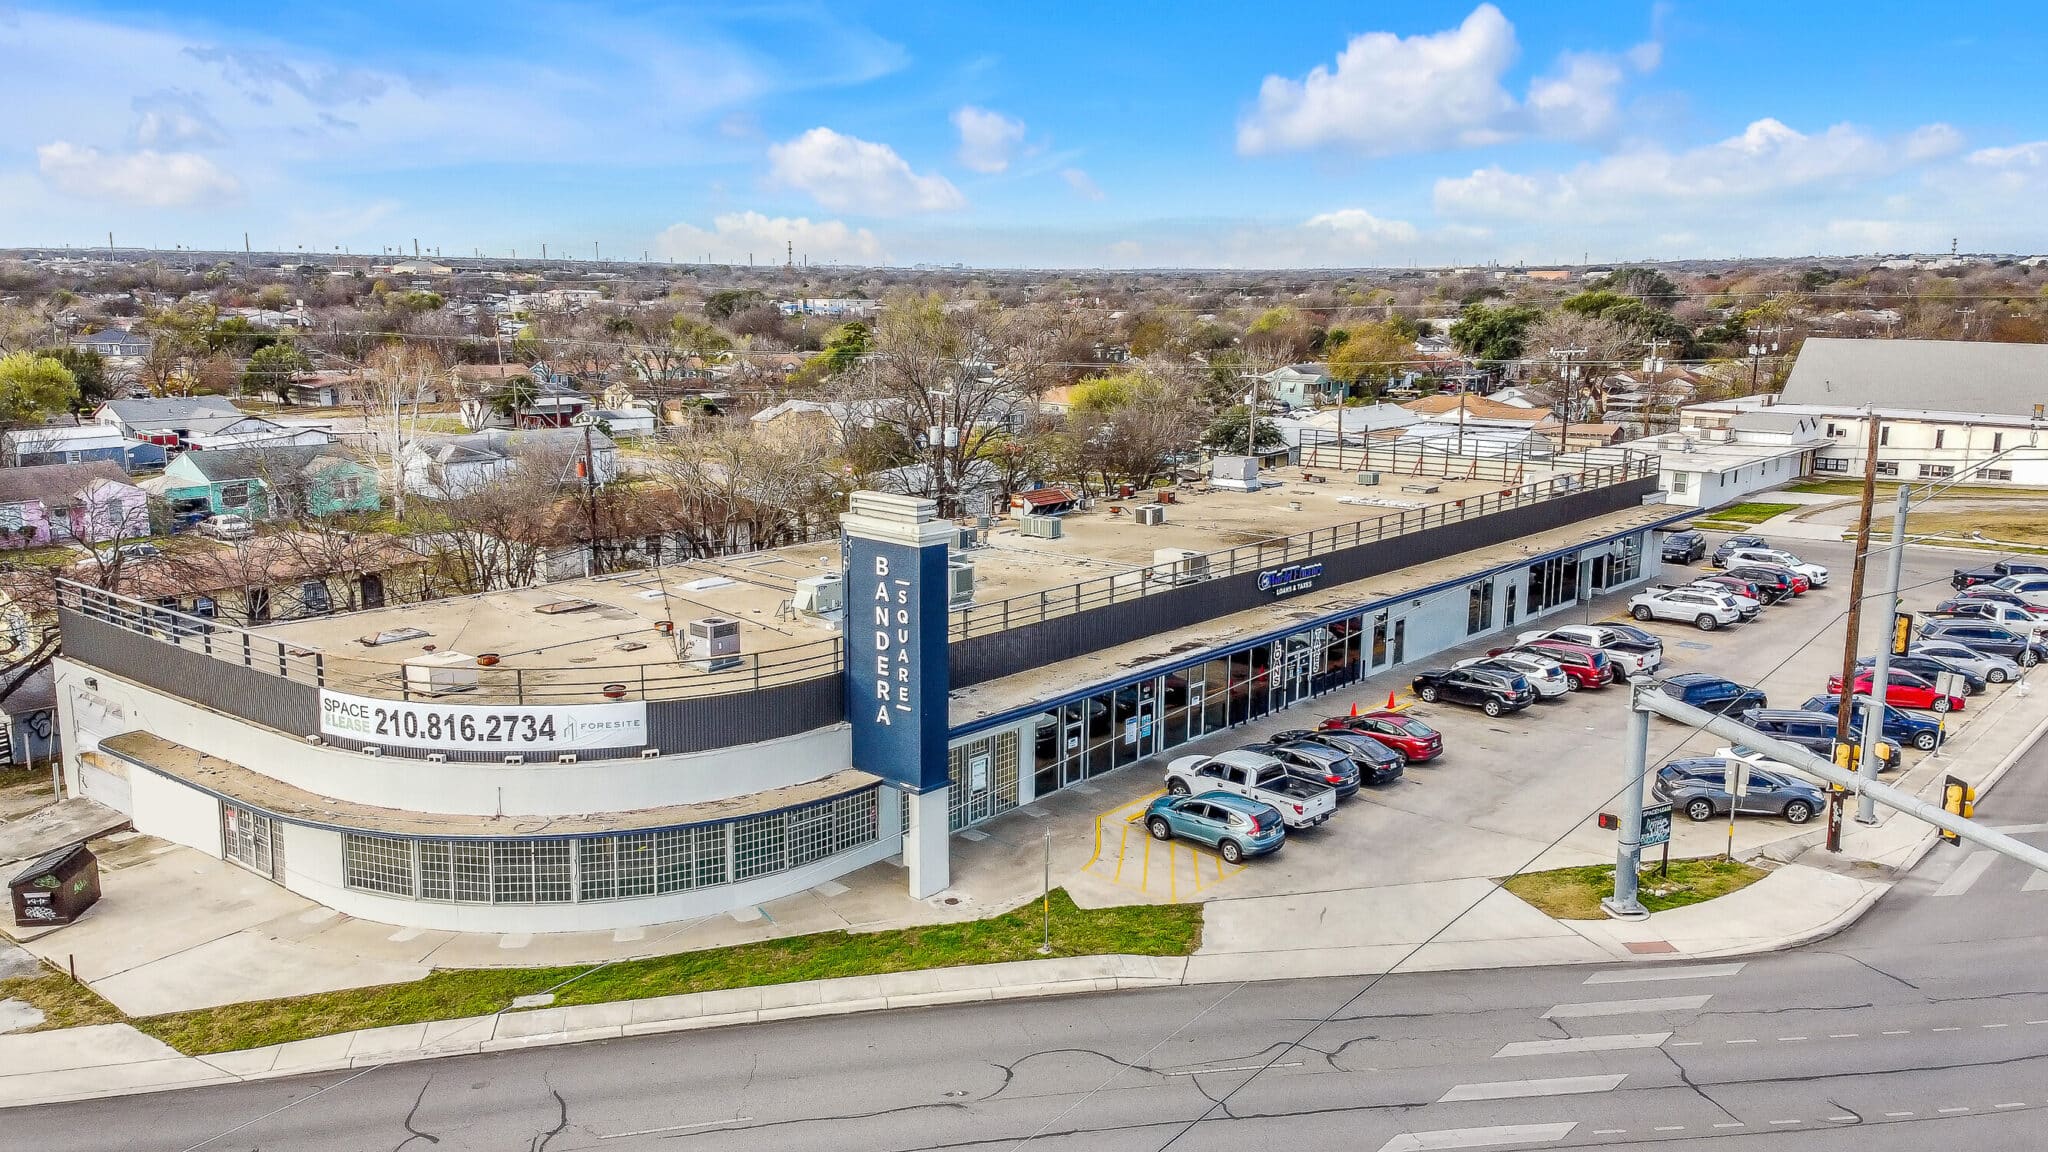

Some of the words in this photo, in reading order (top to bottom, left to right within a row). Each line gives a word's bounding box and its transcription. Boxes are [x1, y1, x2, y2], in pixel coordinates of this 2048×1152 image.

[1276, 586, 1292, 596] LOANS
[1298, 581, 1312, 590] TAXES
[875, 556, 891, 726] BANDERA
[897, 590, 909, 702] SQUARE
[1273, 640, 1281, 687] LOANS
[324, 698, 369, 718] SPACE
[332, 713, 371, 734] LEASE
[374, 707, 557, 742] 210.816.2734
[581, 719, 641, 730] FORESITE
